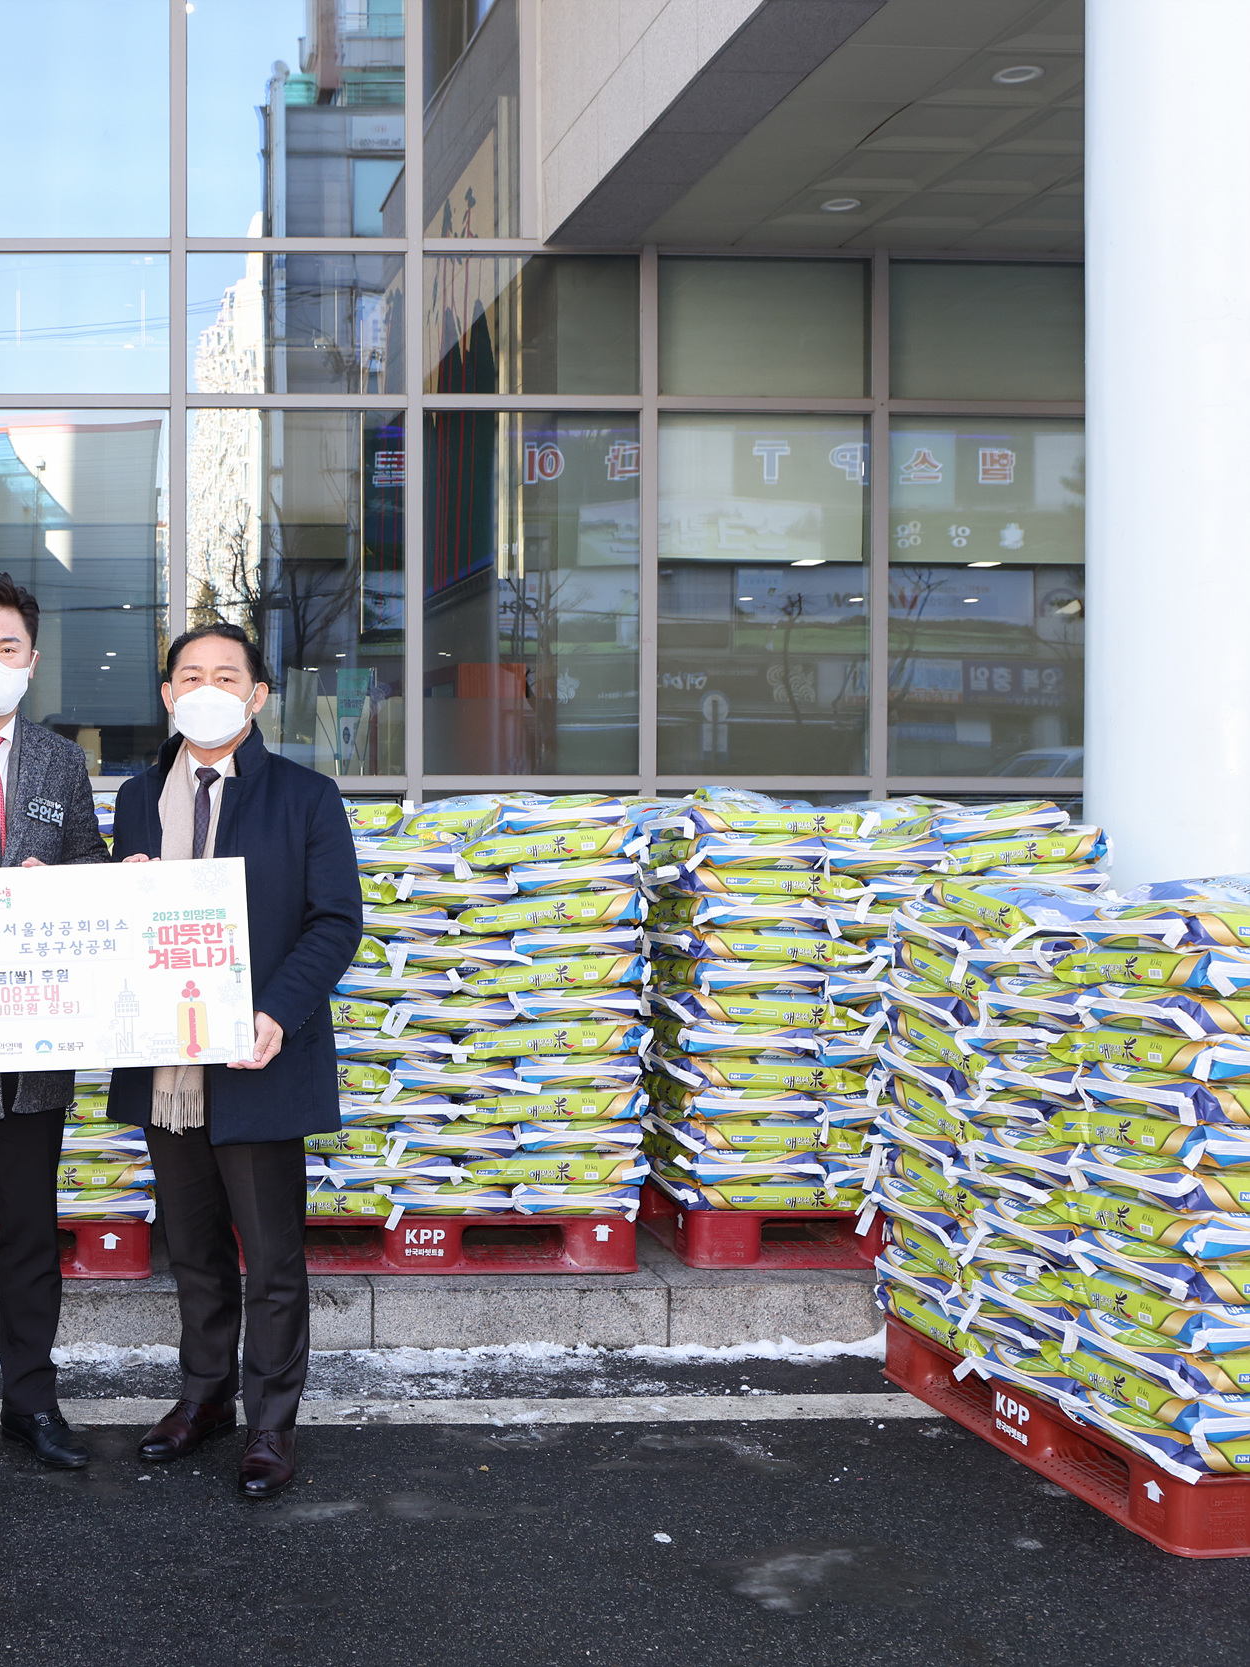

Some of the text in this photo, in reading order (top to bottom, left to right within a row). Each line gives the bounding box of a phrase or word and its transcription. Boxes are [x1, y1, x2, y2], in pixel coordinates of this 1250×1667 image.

[152, 908, 227, 921] 2023 희망온돌
[3, 919, 129, 937] 서울상공회의소
[158, 922, 224, 946] 따뜻한
[19, 939, 116, 957] 도봉구상공회
[148, 945, 236, 970] 겨울나기
[41, 968, 69, 984] 후원
[57, 1041, 84, 1051] 도봉구
[1008, 1200, 1019, 1208] NH
[405, 1229, 446, 1245] KPP
[1006, 1274, 1017, 1282] NH
[1226, 1306, 1244, 1314] NH
[1104, 1314, 1119, 1323] NH
[995, 1391, 1031, 1426] KPP
